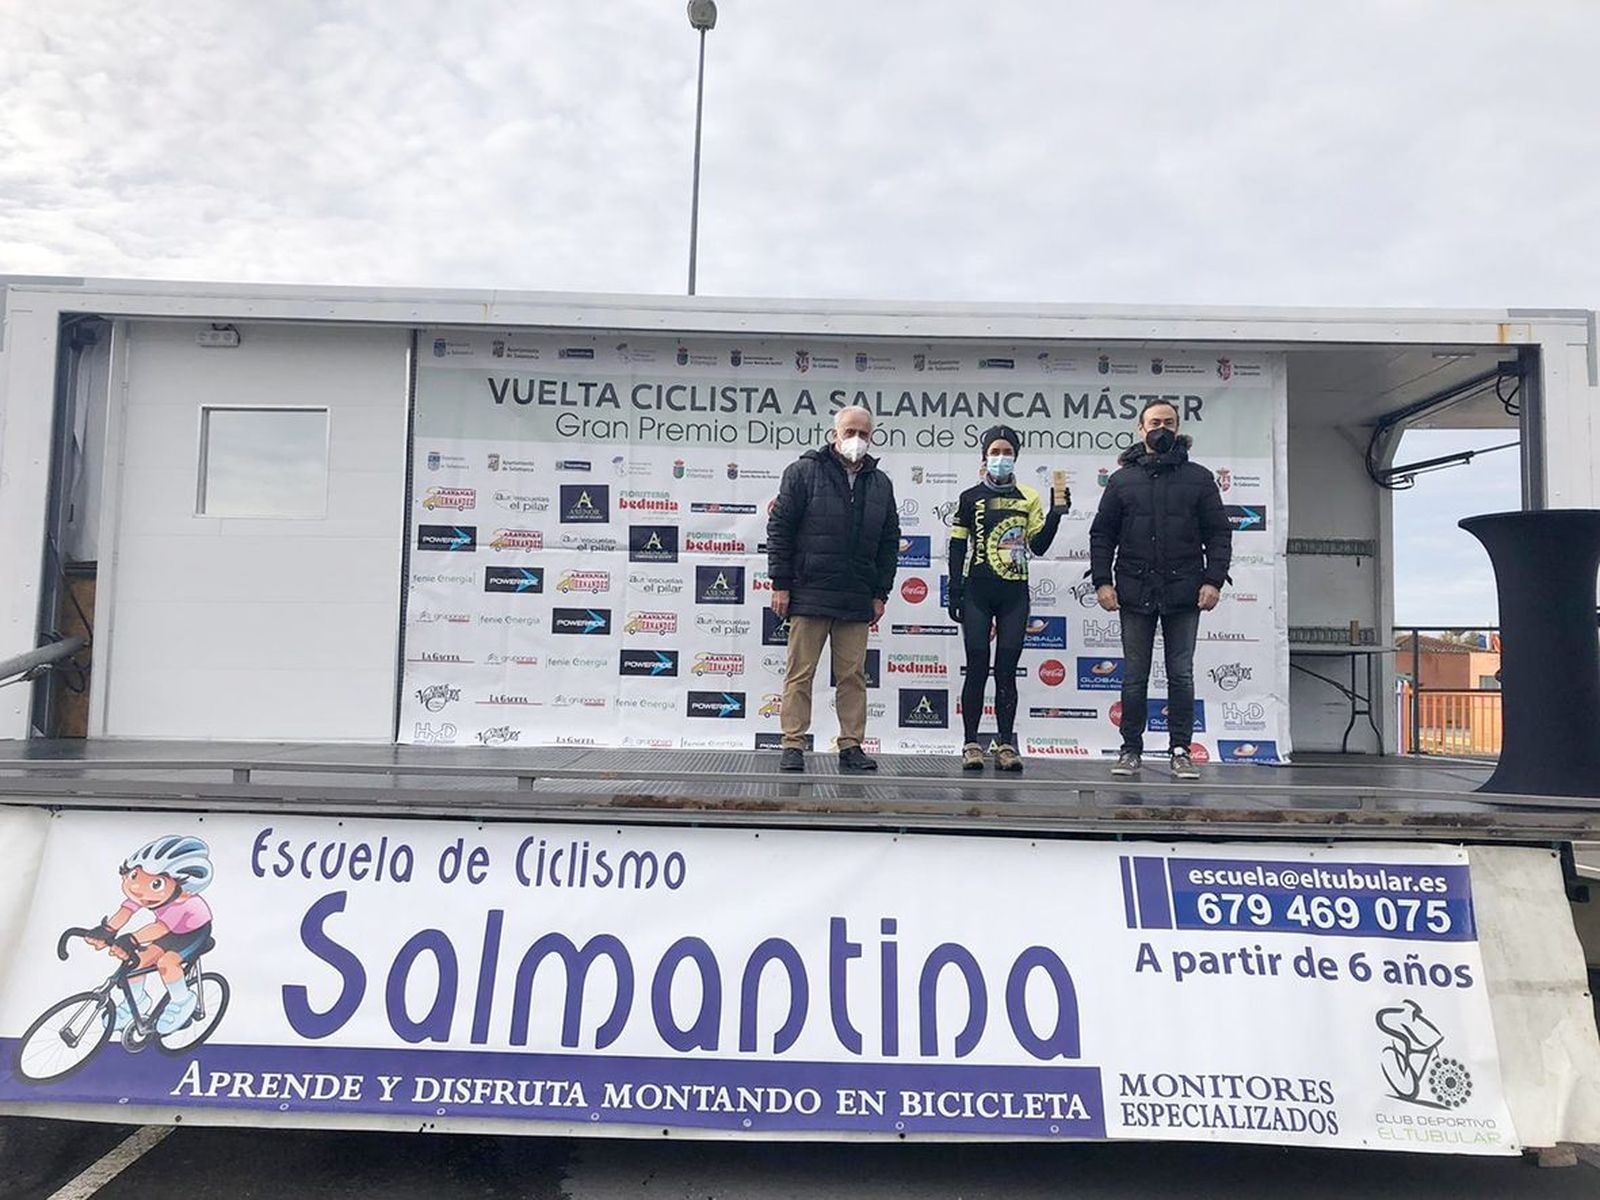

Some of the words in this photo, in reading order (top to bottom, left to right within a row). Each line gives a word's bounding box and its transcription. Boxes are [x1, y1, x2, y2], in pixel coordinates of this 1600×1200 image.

[487, 377, 621, 409] VUELTA
[631, 384, 782, 414] CICLISTA
[792, 389, 817, 416] A
[829, 389, 1051, 419] SALAMANCA
[1064, 386, 1204, 422] MÁSTR
[556, 412, 628, 439] Gran
[639, 416, 738, 444] Premio
[748, 419, 906, 450] Diputón
[916, 425, 954, 448] de
[964, 424, 1134, 450] Smanca
[887, 662, 947, 673] bedunia
[1080, 676, 1122, 684] GLOBAL
[251, 827, 414, 884] Escuela
[438, 838, 490, 884] de
[515, 835, 687, 890] Ciclismo
[1188, 866, 1448, 894] escuela@eltubular.es
[1197, 892, 1272, 926] 679
[1286, 895, 1361, 930] 469
[1374, 897, 1451, 934] 075
[281, 890, 1081, 1061] Salmantina
[1136, 942, 1163, 974] A
[1172, 944, 1282, 982] partir
[1293, 946, 1339, 981] de
[1349, 952, 1372, 982] 6
[1383, 954, 1474, 988] años
[170, 1060, 364, 1102] APRENDE
[376, 1075, 402, 1102] Y
[412, 1077, 588, 1108] DISFRUTA
[602, 1083, 822, 1115] MONTANDO
[836, 1090, 886, 1116] EN
[899, 1091, 1092, 1120] BICICLETA
[1119, 1072, 1335, 1105] MONITORES
[1121, 1102, 1339, 1136] ESPECIALIZADOS
[1376, 1112, 1412, 1127] CLUB
[1417, 1114, 1497, 1129] DEPORTIVO
